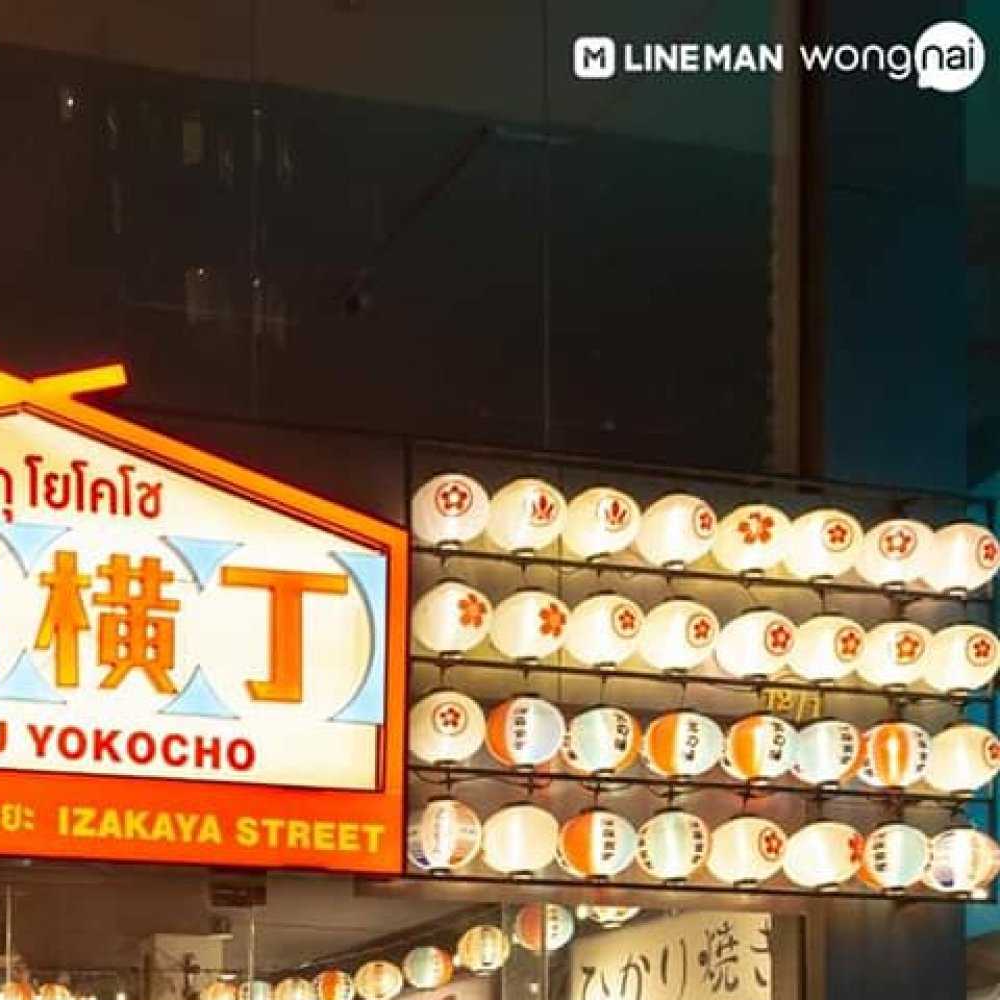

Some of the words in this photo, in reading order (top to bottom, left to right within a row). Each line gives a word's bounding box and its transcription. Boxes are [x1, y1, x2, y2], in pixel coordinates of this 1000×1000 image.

[26, 724, 257, 771] YOKOCHO
[57, 805, 222, 846] IZAKAYA
[236, 819, 386, 856] STREET
